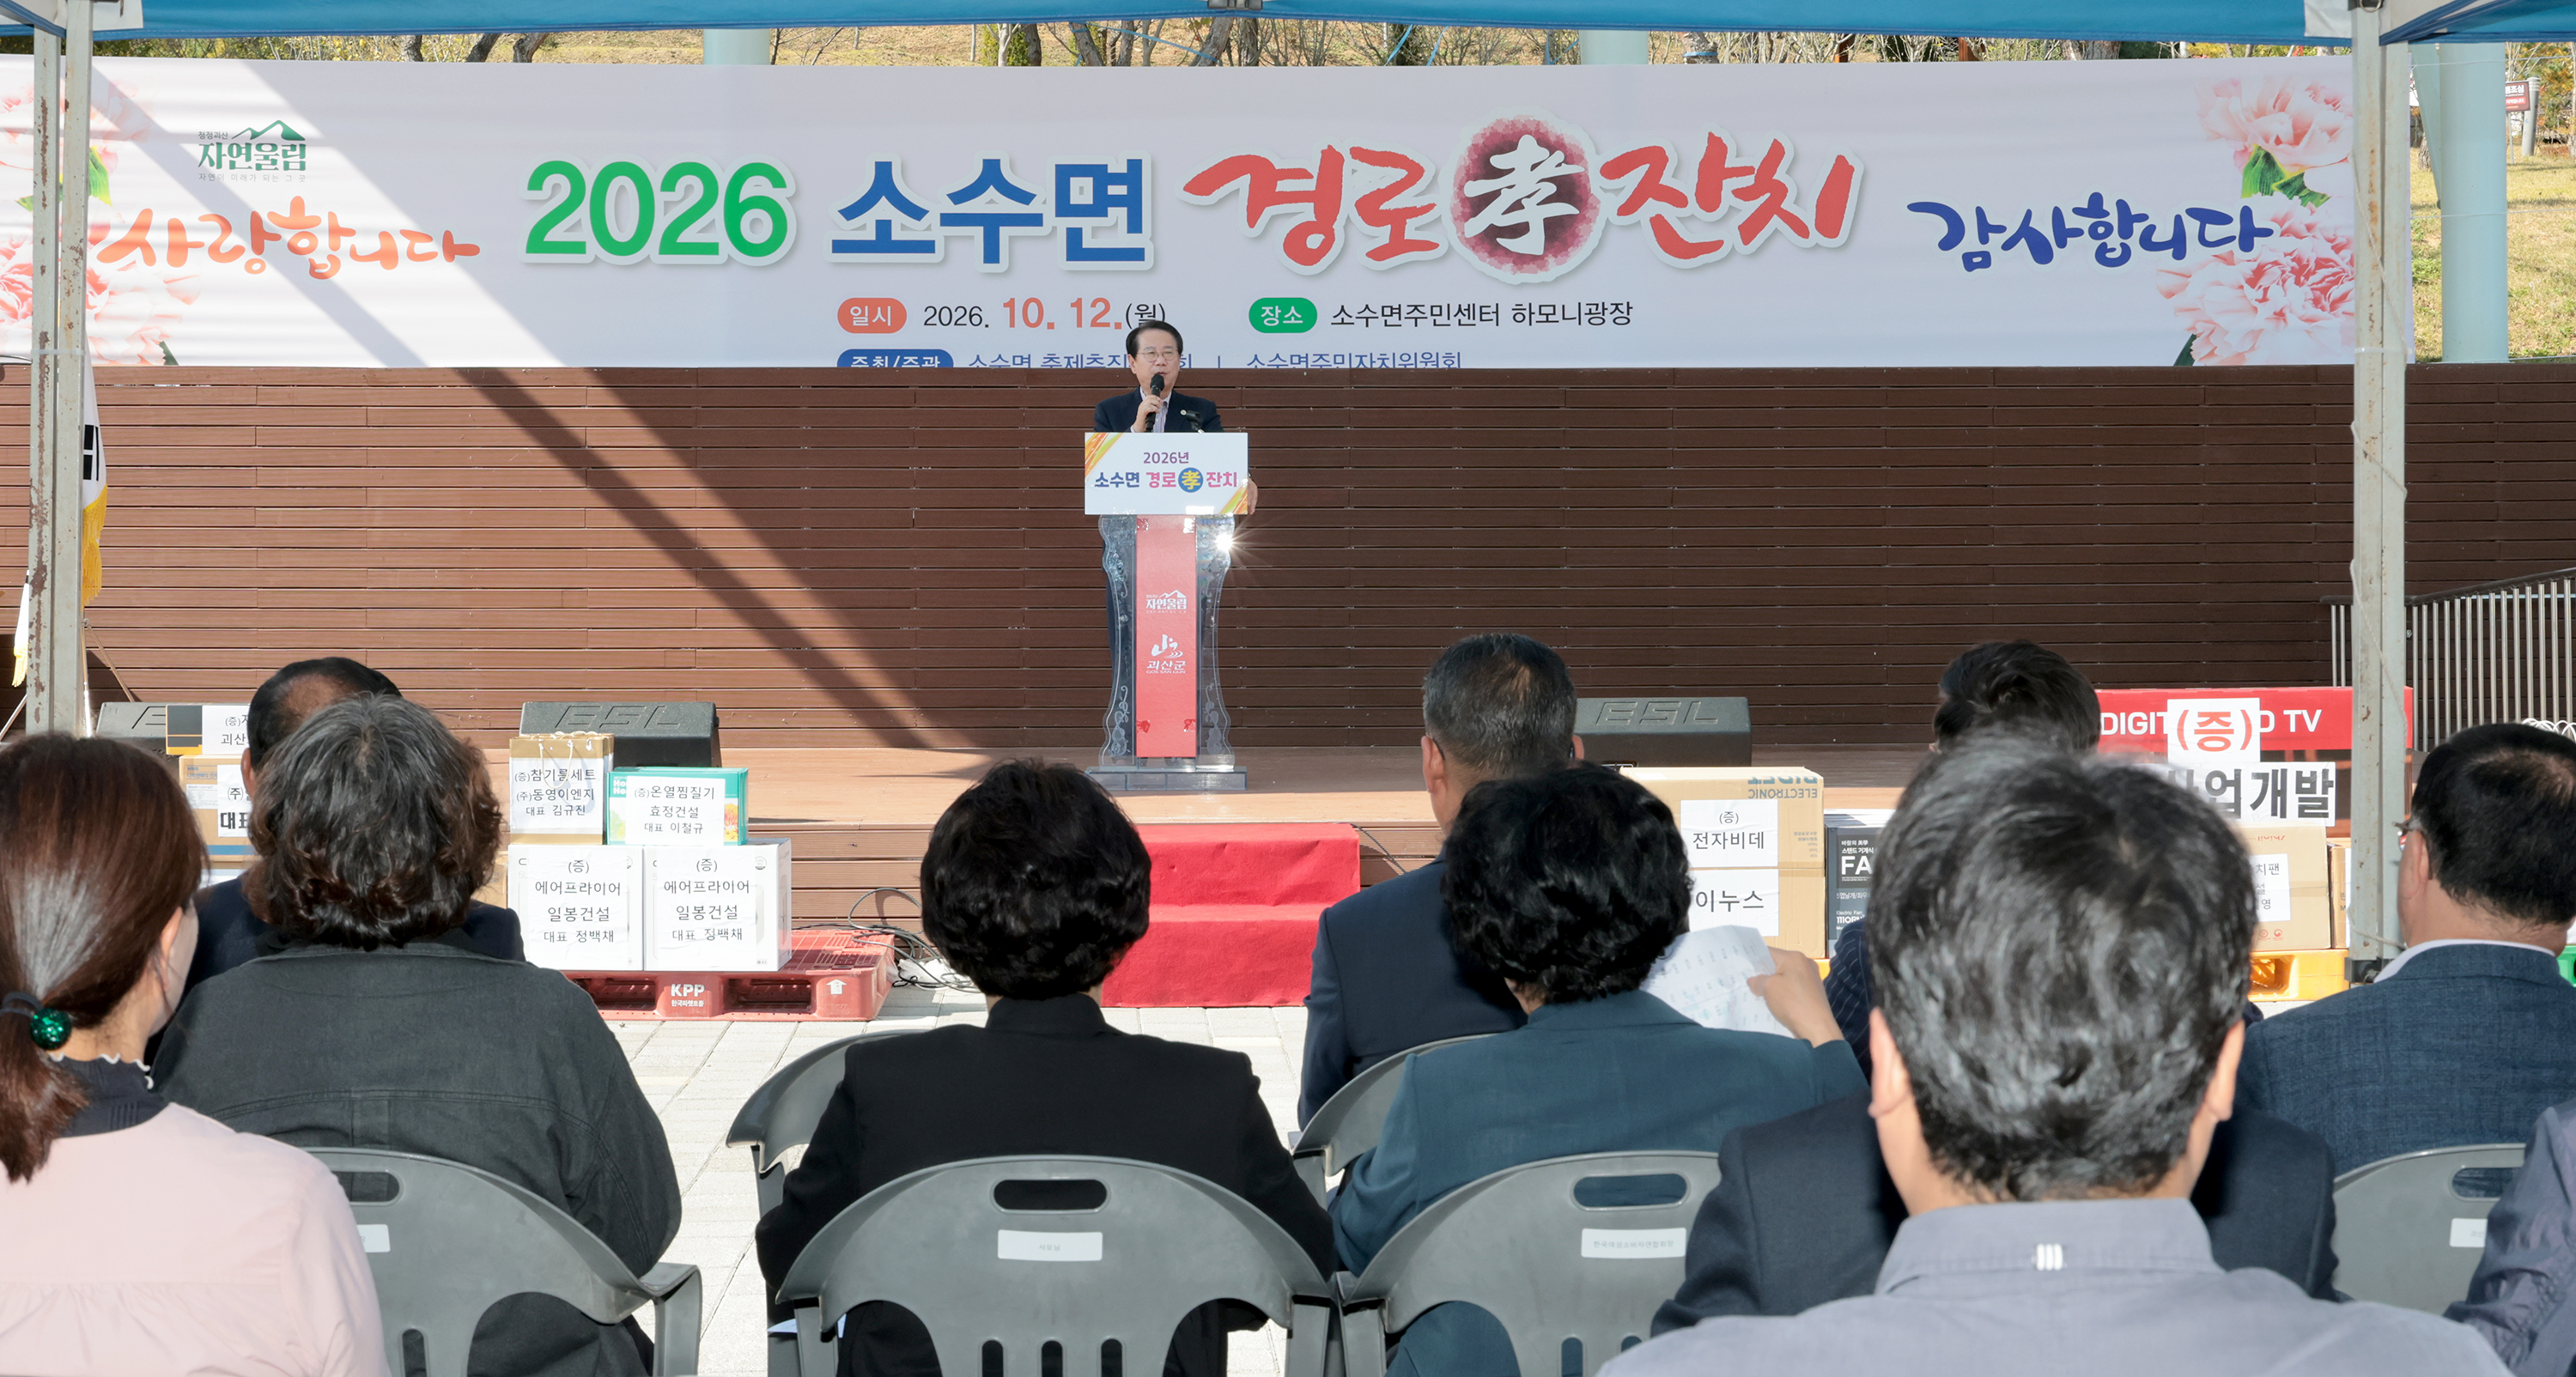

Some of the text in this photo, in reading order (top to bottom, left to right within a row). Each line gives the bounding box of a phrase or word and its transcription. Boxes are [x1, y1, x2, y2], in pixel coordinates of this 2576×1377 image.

[198, 131, 228, 140] 청정괴산
[197, 143, 307, 171] 자연울림
[198, 173, 225, 182] 자연이
[263, 174, 279, 183] 되는
[525, 160, 788, 257] 2026
[831, 158, 1146, 264] 소수면
[96, 195, 481, 280] 사랑합니다
[1907, 191, 2275, 272] 감사합니다
[849, 305, 893, 327] 일시
[923, 306, 989, 327] 2026.
[1003, 297, 1055, 330] 10.
[1261, 300, 1634, 328] 장소 소수면주민센터 하모니광장
[1143, 452, 1189, 464] 2026년
[1094, 471, 1140, 488] 소수면
[1145, 598, 1188, 610] 자연울림
[1146, 660, 1187, 670] 괴산군
[555, 705, 681, 729] ESL
[1595, 701, 1719, 726] ESL
[2099, 711, 2169, 736] DIGIT
[2282, 708, 2323, 733] TV
[2176, 709, 2254, 753] (증)
[514, 768, 597, 783] (증)참기름세트
[516, 788, 595, 803] (주)동영이엔지
[634, 785, 715, 800] (증)온열찜질기
[1747, 788, 1818, 799] ELECTRONIC
[526, 804, 586, 816] 대표 김규진
[649, 805, 700, 819] 효정건설
[1718, 810, 1740, 825] (증)
[644, 822, 703, 834] 대표 이철규
[1692, 831, 1765, 851] 전자비데
[568, 859, 590, 874] (증)
[696, 858, 718, 873] (증)
[1841, 855, 1873, 876] FA
[534, 881, 622, 896] 에어프라이어
[663, 879, 750, 895] 에어프라이어
[1695, 889, 1765, 913] 이누스
[547, 906, 611, 923] 일봉건설
[676, 904, 738, 921] 일봉건설
[544, 930, 615, 943] 대표 정백채
[671, 927, 744, 942] 대표 정백채
[671, 983, 706, 998] KPP
